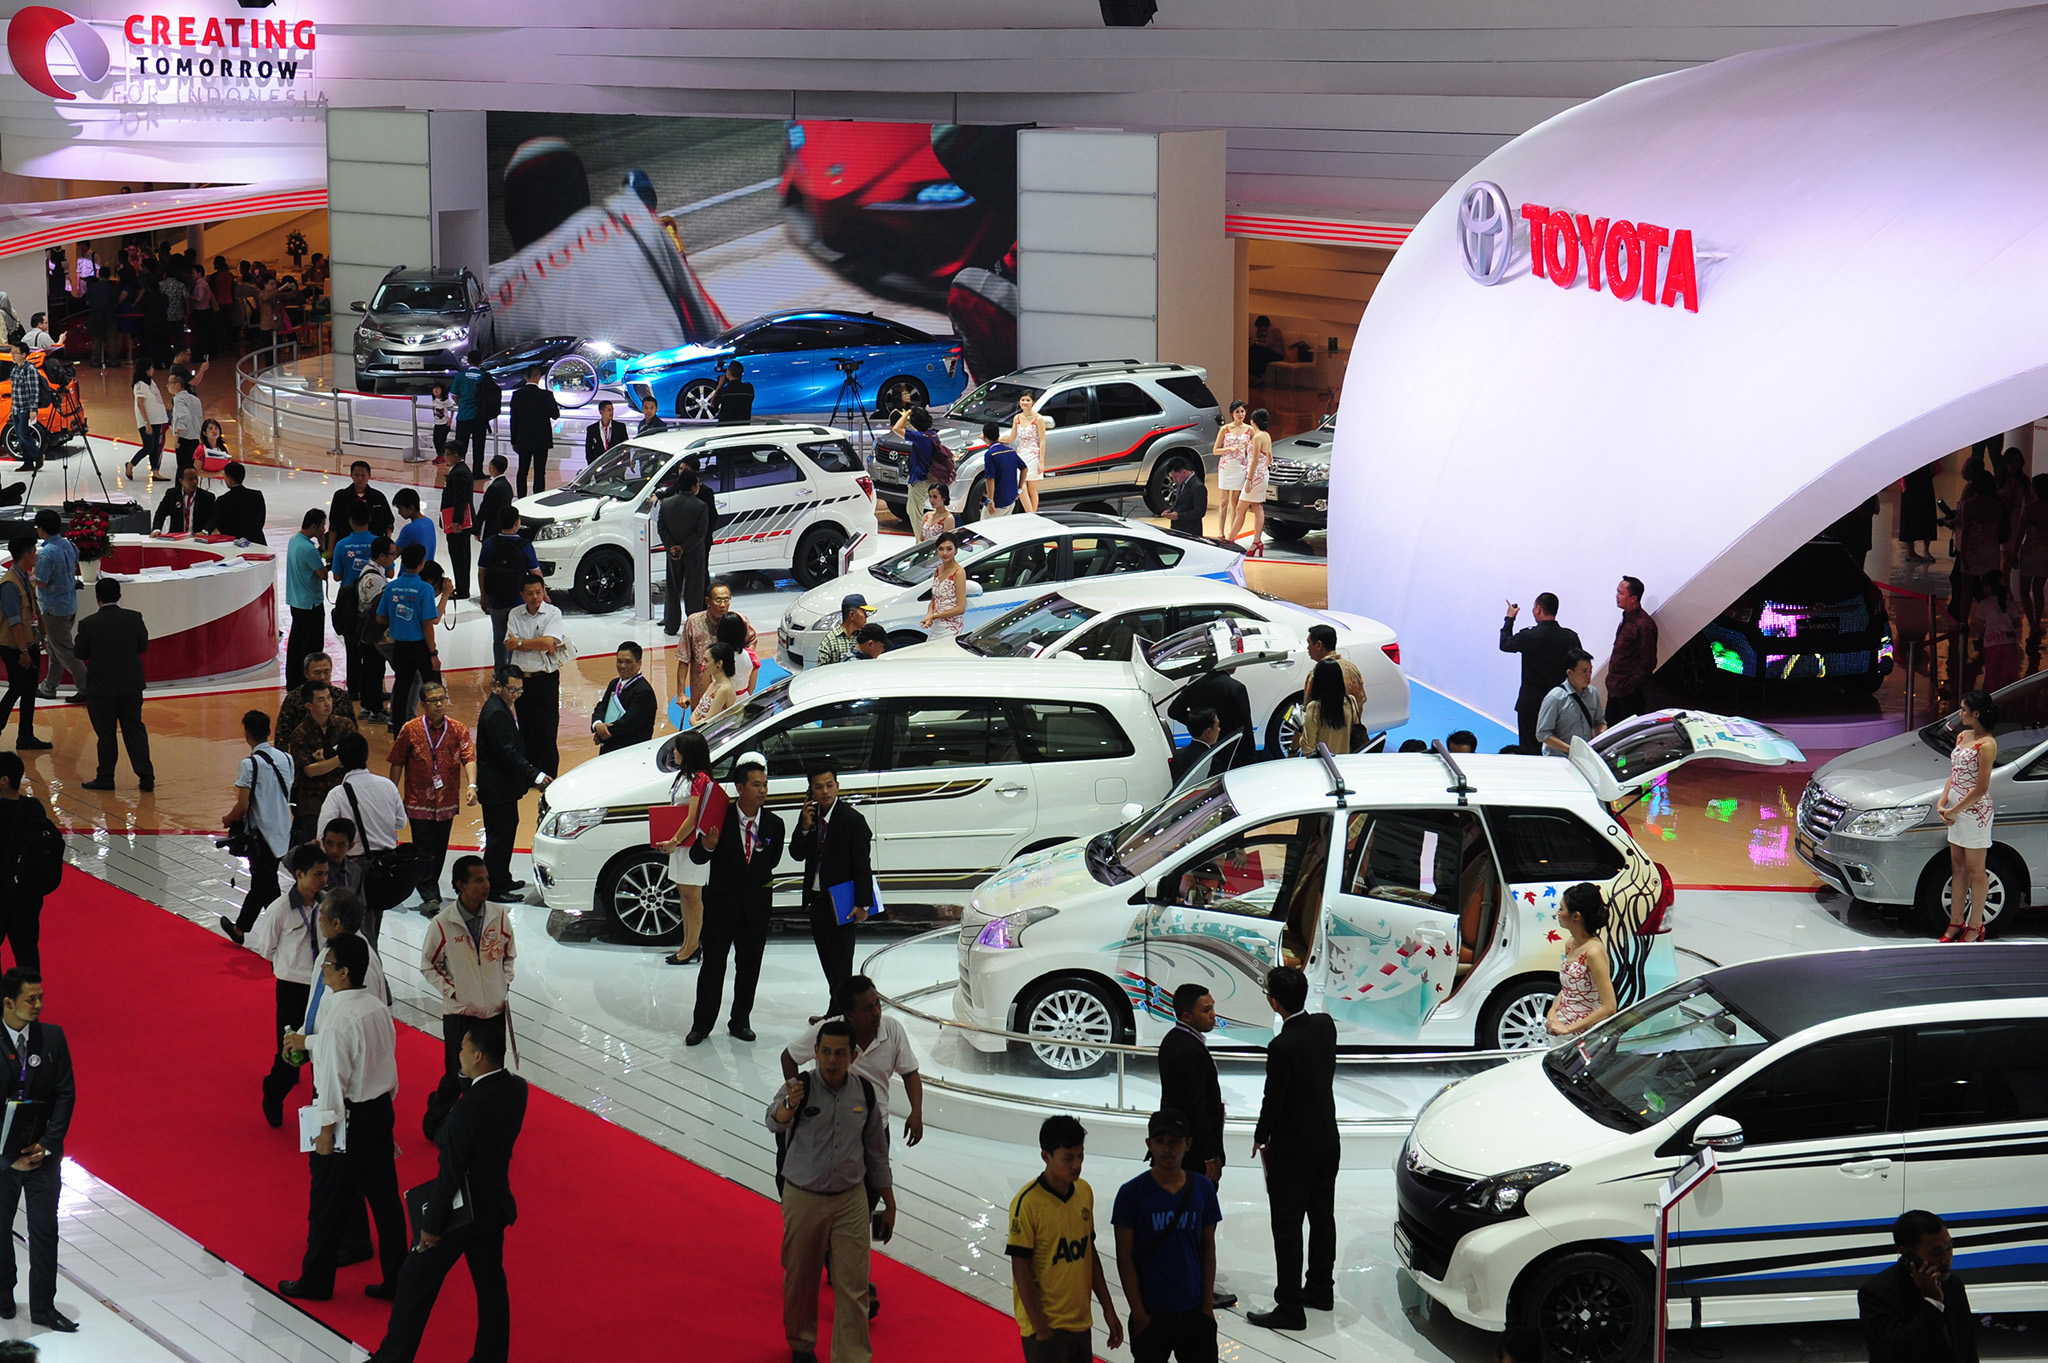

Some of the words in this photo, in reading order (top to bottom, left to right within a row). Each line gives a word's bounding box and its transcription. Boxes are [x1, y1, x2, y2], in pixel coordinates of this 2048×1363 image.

[124, 14, 316, 50] CREATING
[137, 57, 298, 80] TOMORROW
[112, 85, 160, 103] FOR
[177, 87, 329, 108] INDONESIA
[1521, 203, 1698, 313] TOYOTA
